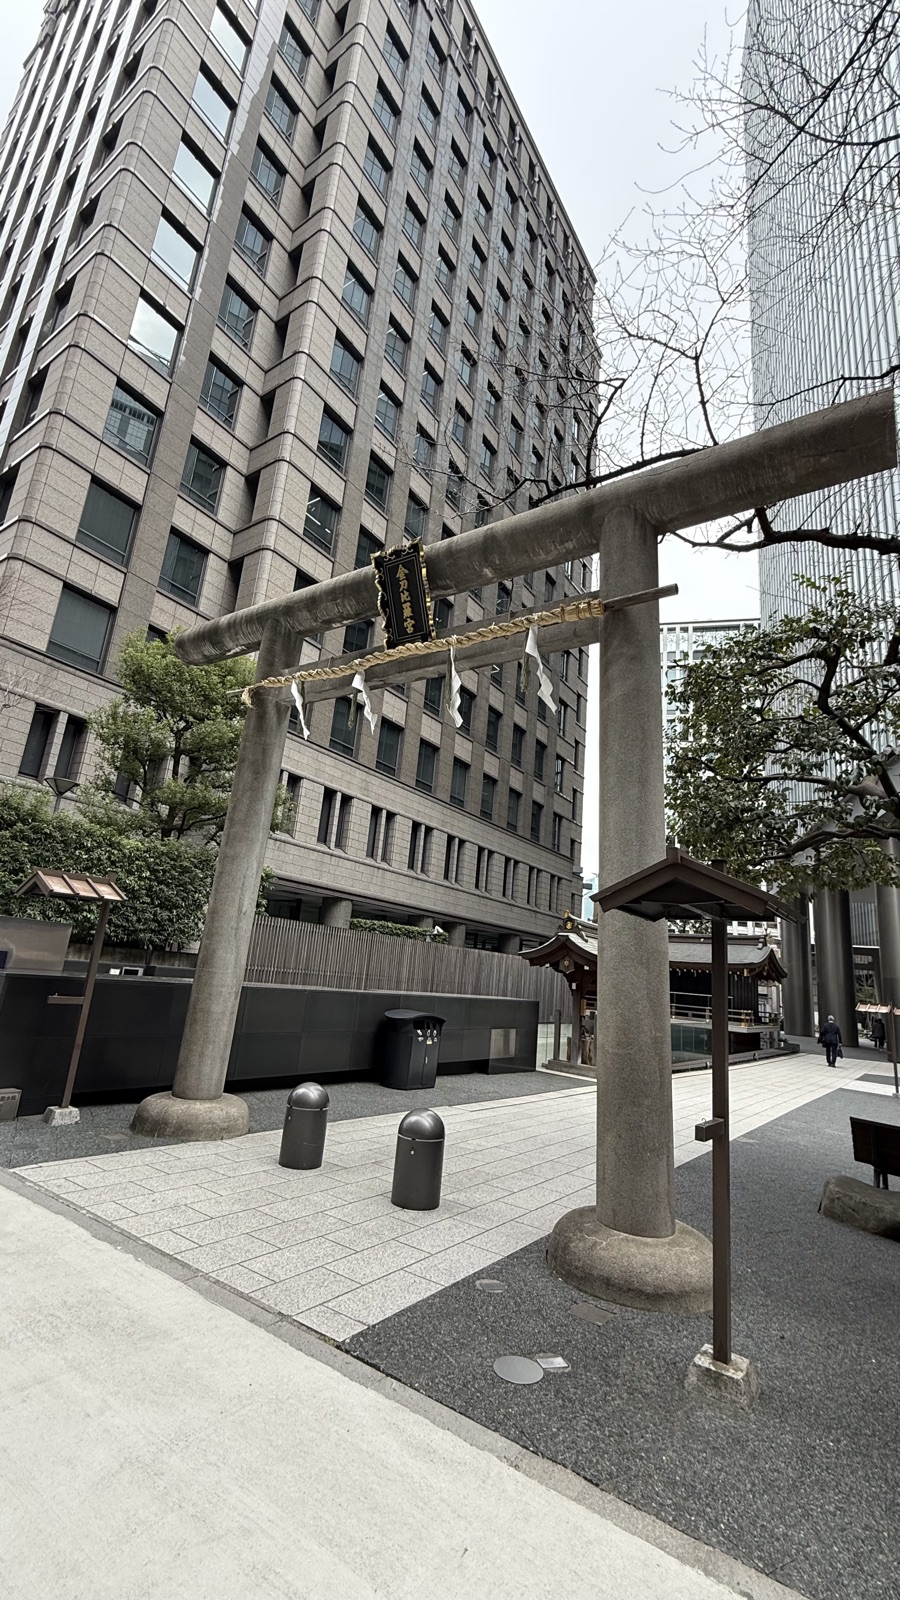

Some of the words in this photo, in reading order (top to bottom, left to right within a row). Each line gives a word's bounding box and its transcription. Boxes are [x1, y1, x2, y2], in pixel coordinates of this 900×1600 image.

[395, 563, 415, 634] 金刀比羅宮
